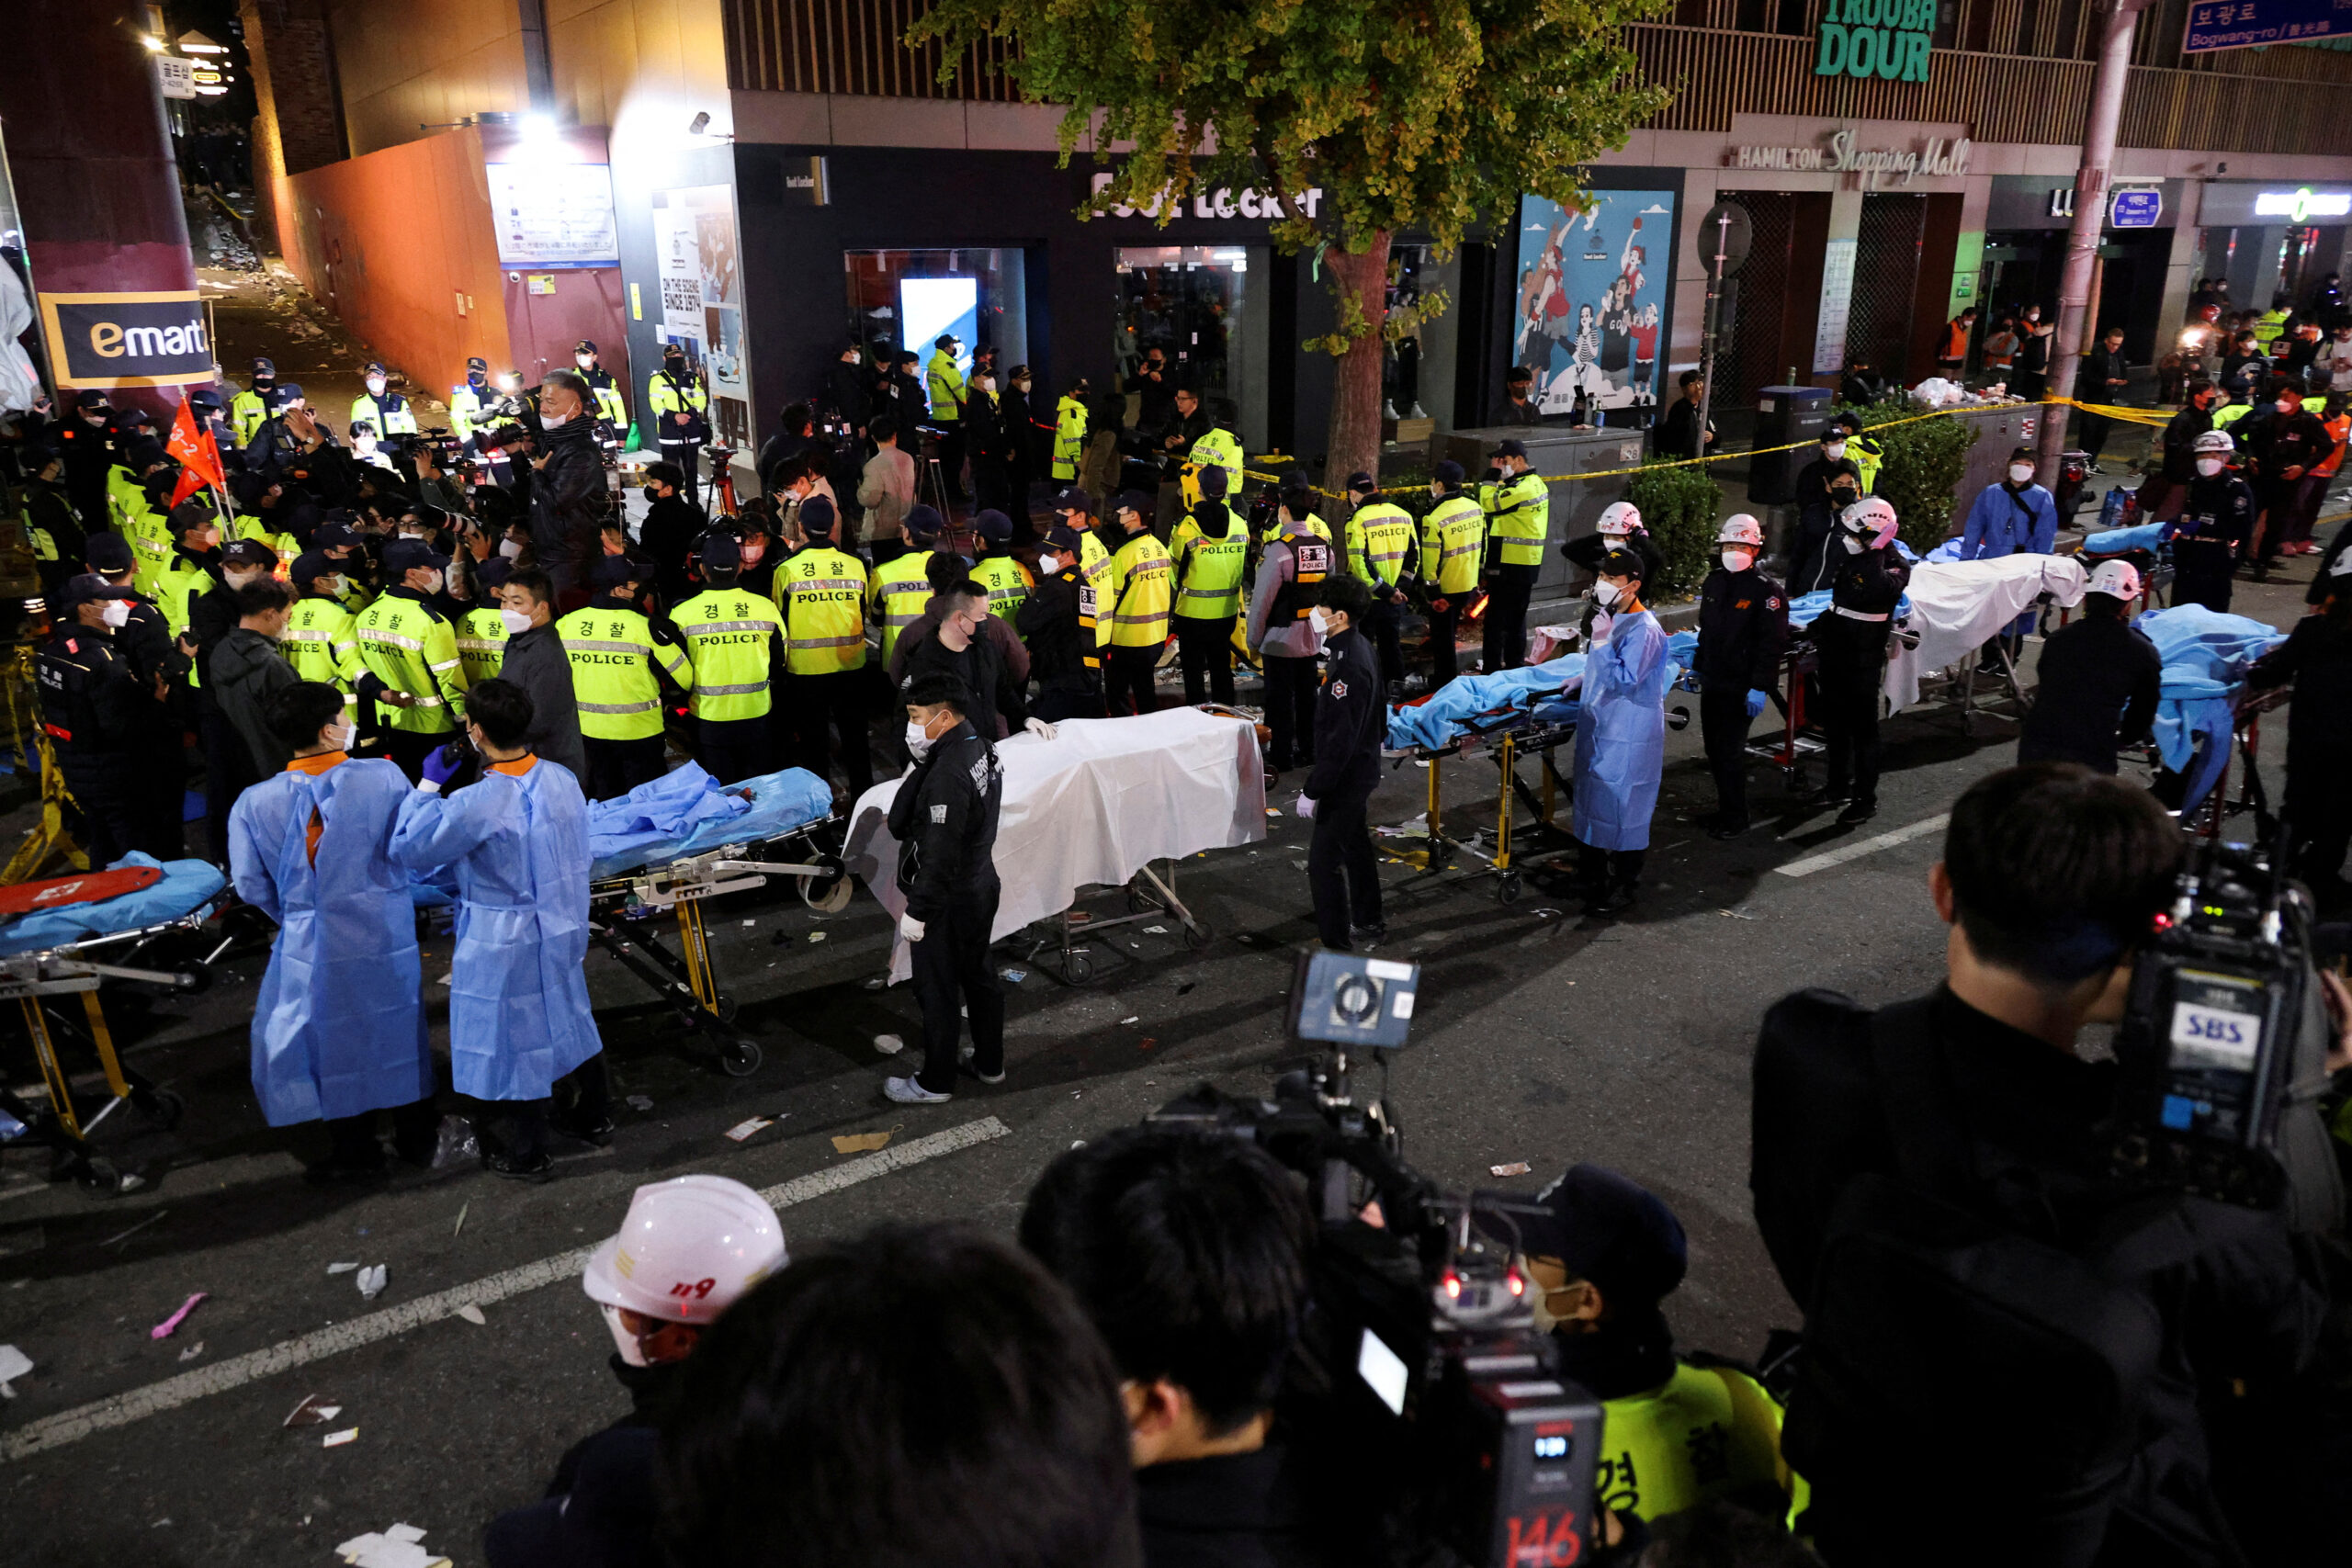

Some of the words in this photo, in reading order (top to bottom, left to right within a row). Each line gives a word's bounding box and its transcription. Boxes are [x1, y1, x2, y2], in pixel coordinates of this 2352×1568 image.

[2191, 28, 2277, 47] Bogwang-ro
[1815, 23, 1931, 82] DOUR
[1739, 146, 1822, 169] HAMILTON
[1827, 129, 1917, 190] Shopping
[1915, 137, 1970, 176] Mall
[1371, 528, 1407, 539] POLICE
[1451, 519, 1481, 535] POLICE
[1201, 545, 1244, 555] POLICE
[797, 592, 855, 604] POLICE
[989, 598, 1026, 612] POLIC
[700, 633, 761, 647] POLICE
[363, 641, 405, 659] POLICE
[460, 651, 503, 663] POLIC
[571, 653, 634, 665] POLICE
[2187, 1014, 2243, 1043] SBS
[670, 1278, 716, 1300] 119
[1506, 1511, 1581, 1568] 146
